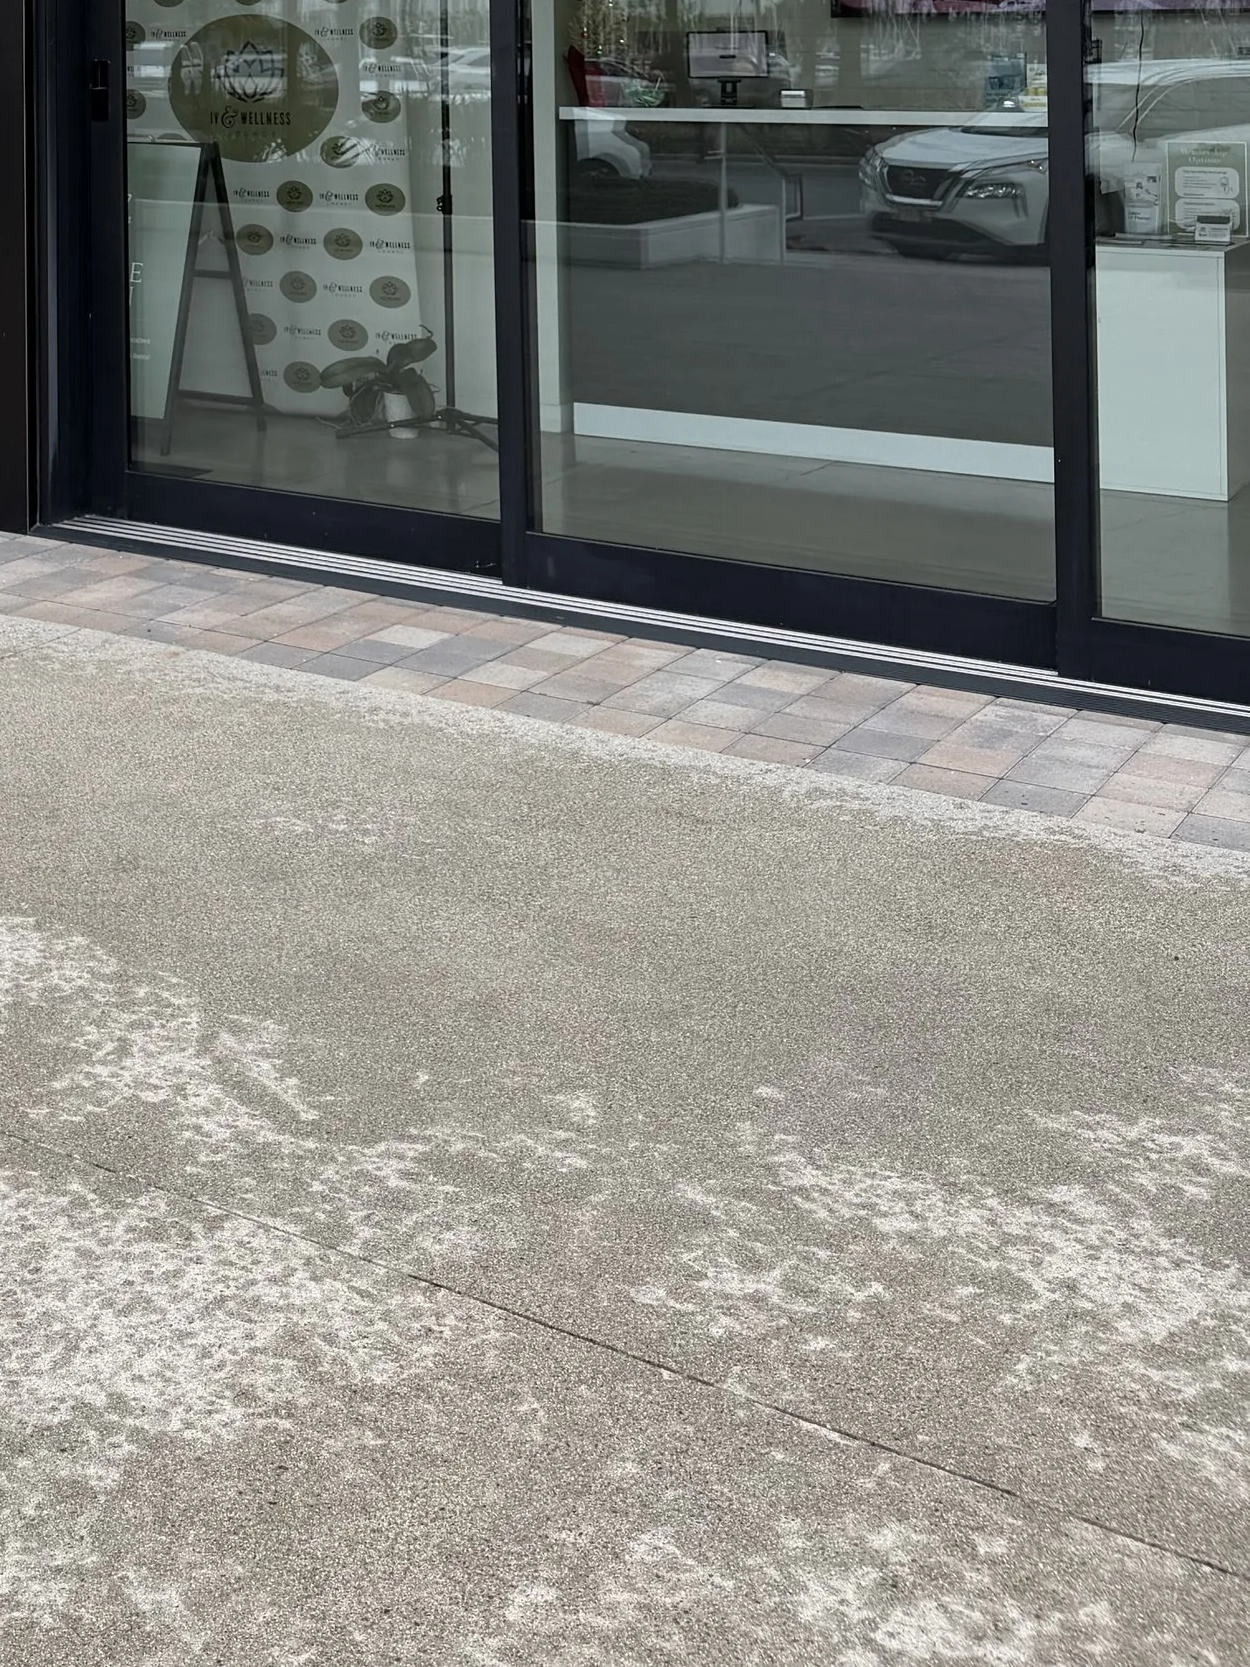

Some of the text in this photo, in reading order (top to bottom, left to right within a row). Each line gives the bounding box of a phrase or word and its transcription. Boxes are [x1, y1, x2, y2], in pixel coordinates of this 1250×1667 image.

[210, 105, 292, 129] IV & WELLNESS
